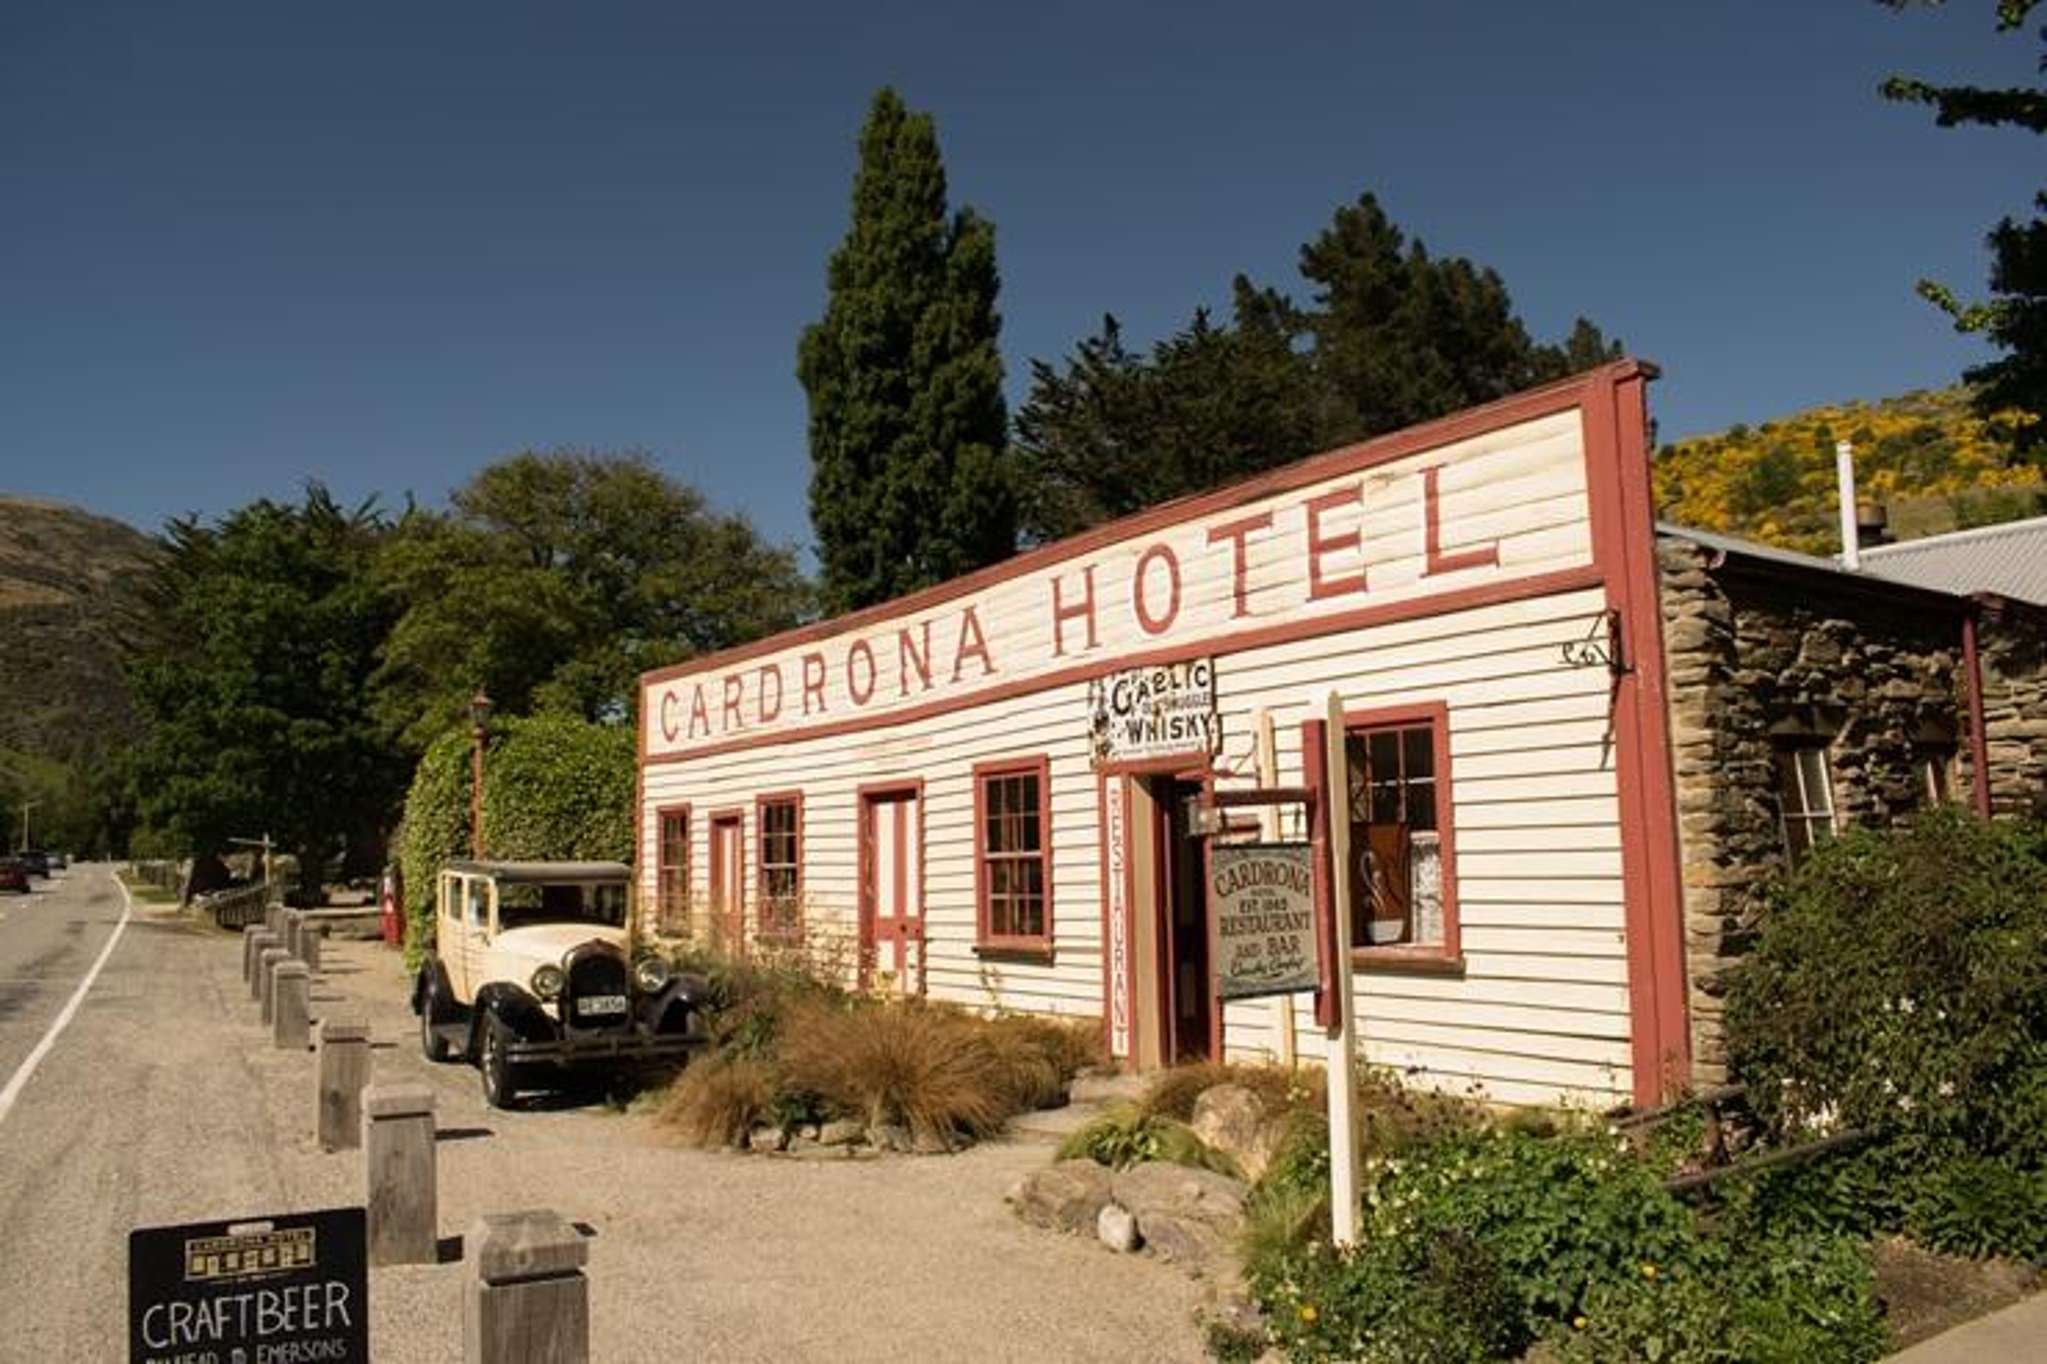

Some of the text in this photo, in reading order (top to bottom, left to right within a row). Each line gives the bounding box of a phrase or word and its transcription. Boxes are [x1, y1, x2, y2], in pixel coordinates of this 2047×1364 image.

[660, 463, 1501, 742] CARDRONA HOTEL
[1125, 713, 1211, 744] WHISKY
[1214, 860, 1310, 898] CARDRONA
[1109, 787, 1126, 1051] RESTAURANT
[1219, 912, 1311, 937] RESTAURANT
[1266, 935, 1302, 956] BAR
